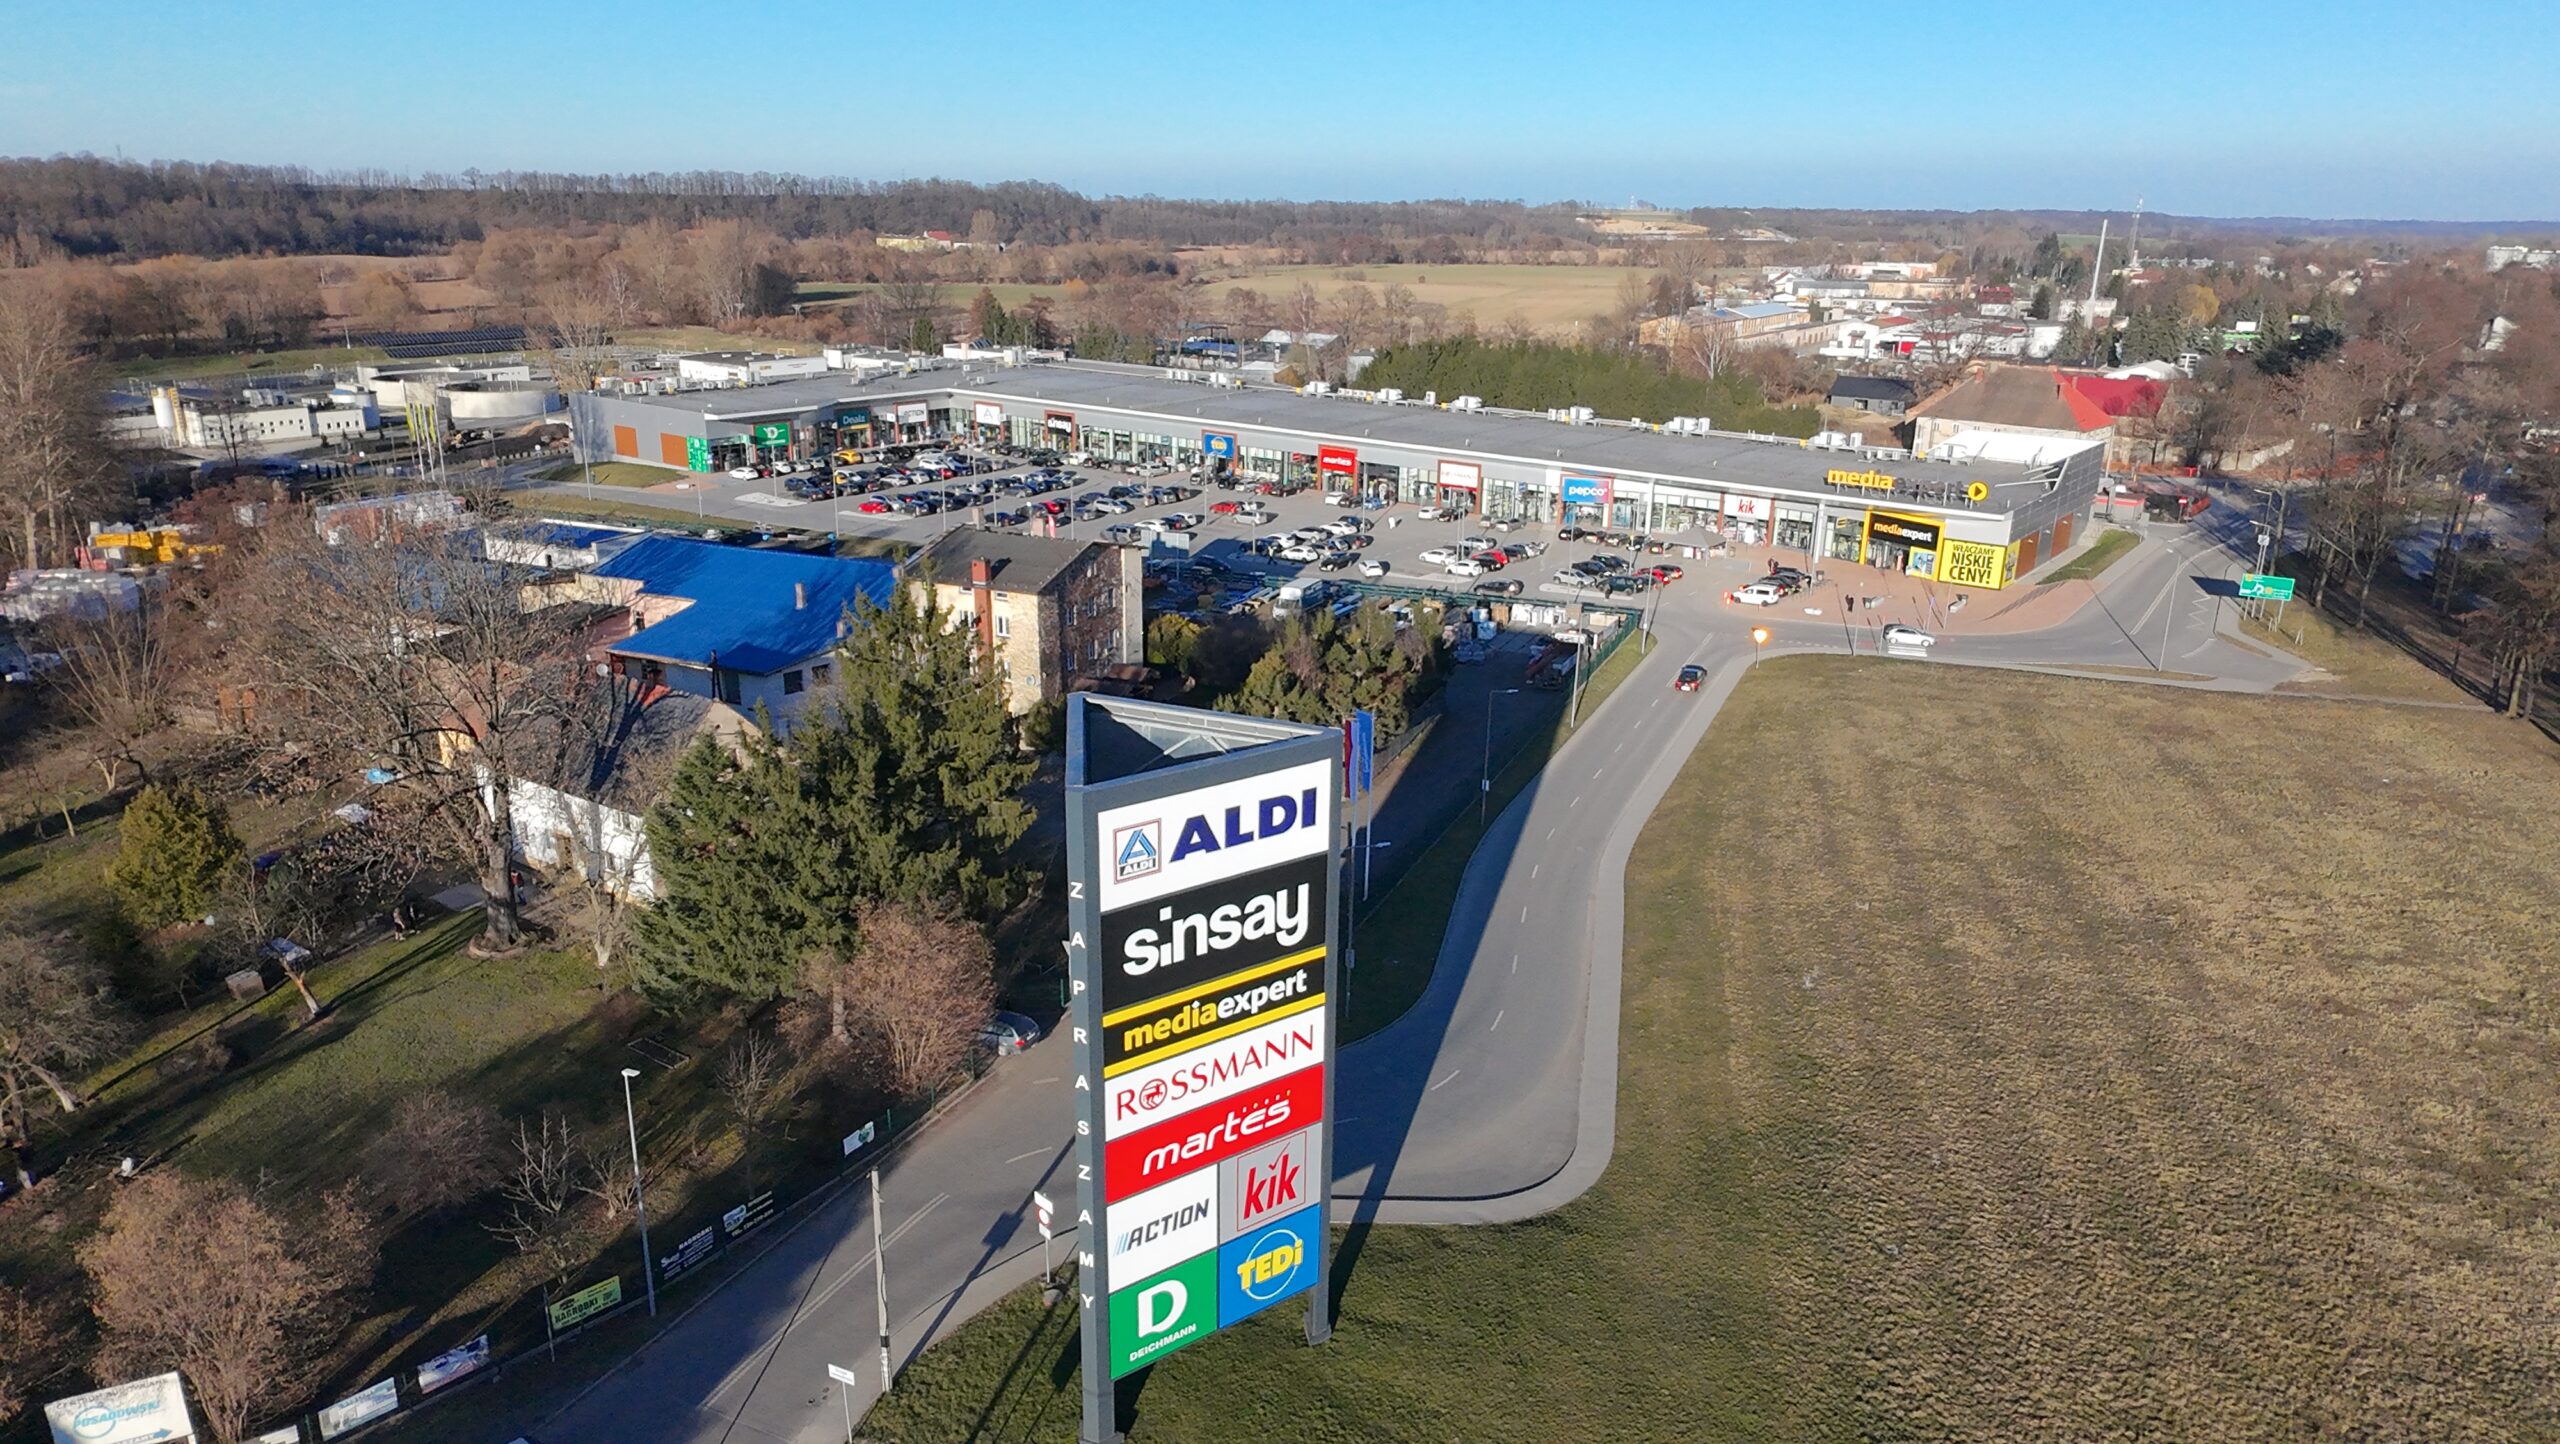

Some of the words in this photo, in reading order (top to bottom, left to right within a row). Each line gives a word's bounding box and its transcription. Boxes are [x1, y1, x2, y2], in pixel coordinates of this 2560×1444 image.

[1568, 486, 1605, 497] pepco
[1827, 469, 1894, 490] media
[1737, 498, 1755, 515] kik
[1949, 565, 1992, 585] CENY!
[1950, 551, 1994, 570] NISKIE
[1169, 787, 1317, 864] ALDI
[1122, 858, 1156, 876] ALDI
[1122, 882, 1310, 977] sinsay
[1123, 968, 1307, 1051] mediaexpert
[1116, 1024, 1315, 1121] ROSSMANN
[1243, 1142, 1301, 1220] kik
[1125, 1197, 1210, 1251] ACTION
[1237, 1238, 1304, 1291] TEDi
[1138, 1279, 1188, 1338] D
[1129, 1323, 1197, 1362] DEICHMANN
